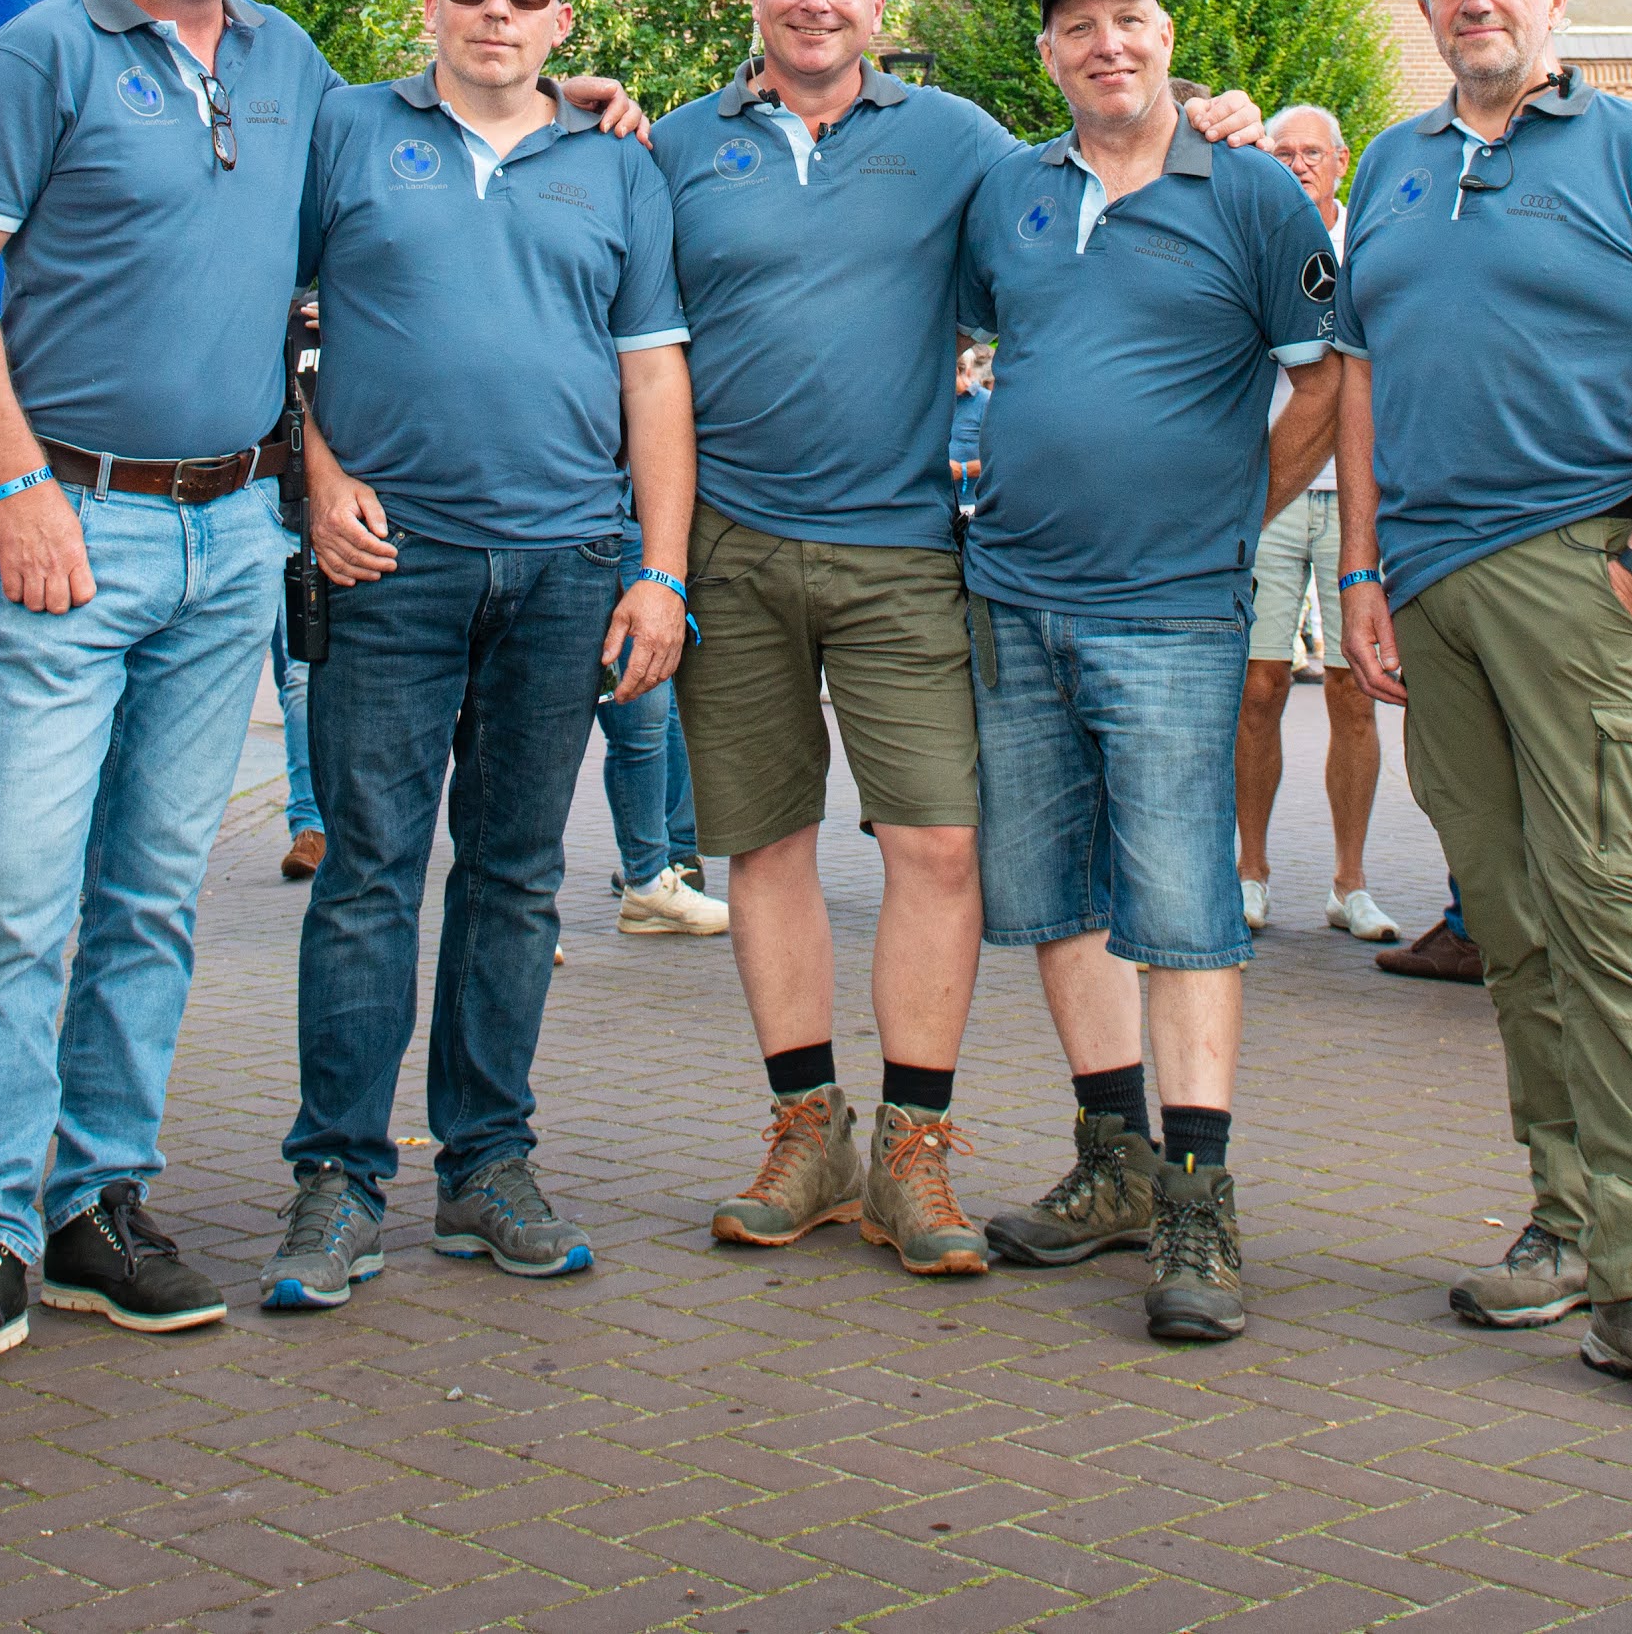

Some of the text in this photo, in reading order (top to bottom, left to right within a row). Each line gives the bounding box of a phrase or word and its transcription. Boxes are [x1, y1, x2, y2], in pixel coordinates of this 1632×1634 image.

[396, 141, 433, 153] BMW
[719, 140, 754, 156] BMW
[859, 167, 917, 177] UDENHOUT.NL
[405, 182, 449, 190] Laarhoven
[538, 192, 596, 212] UDENHOUT.NL
[1506, 207, 1568, 223] UDENHOUT.NL
[1134, 245, 1196, 269] UDENHOUT.NL
